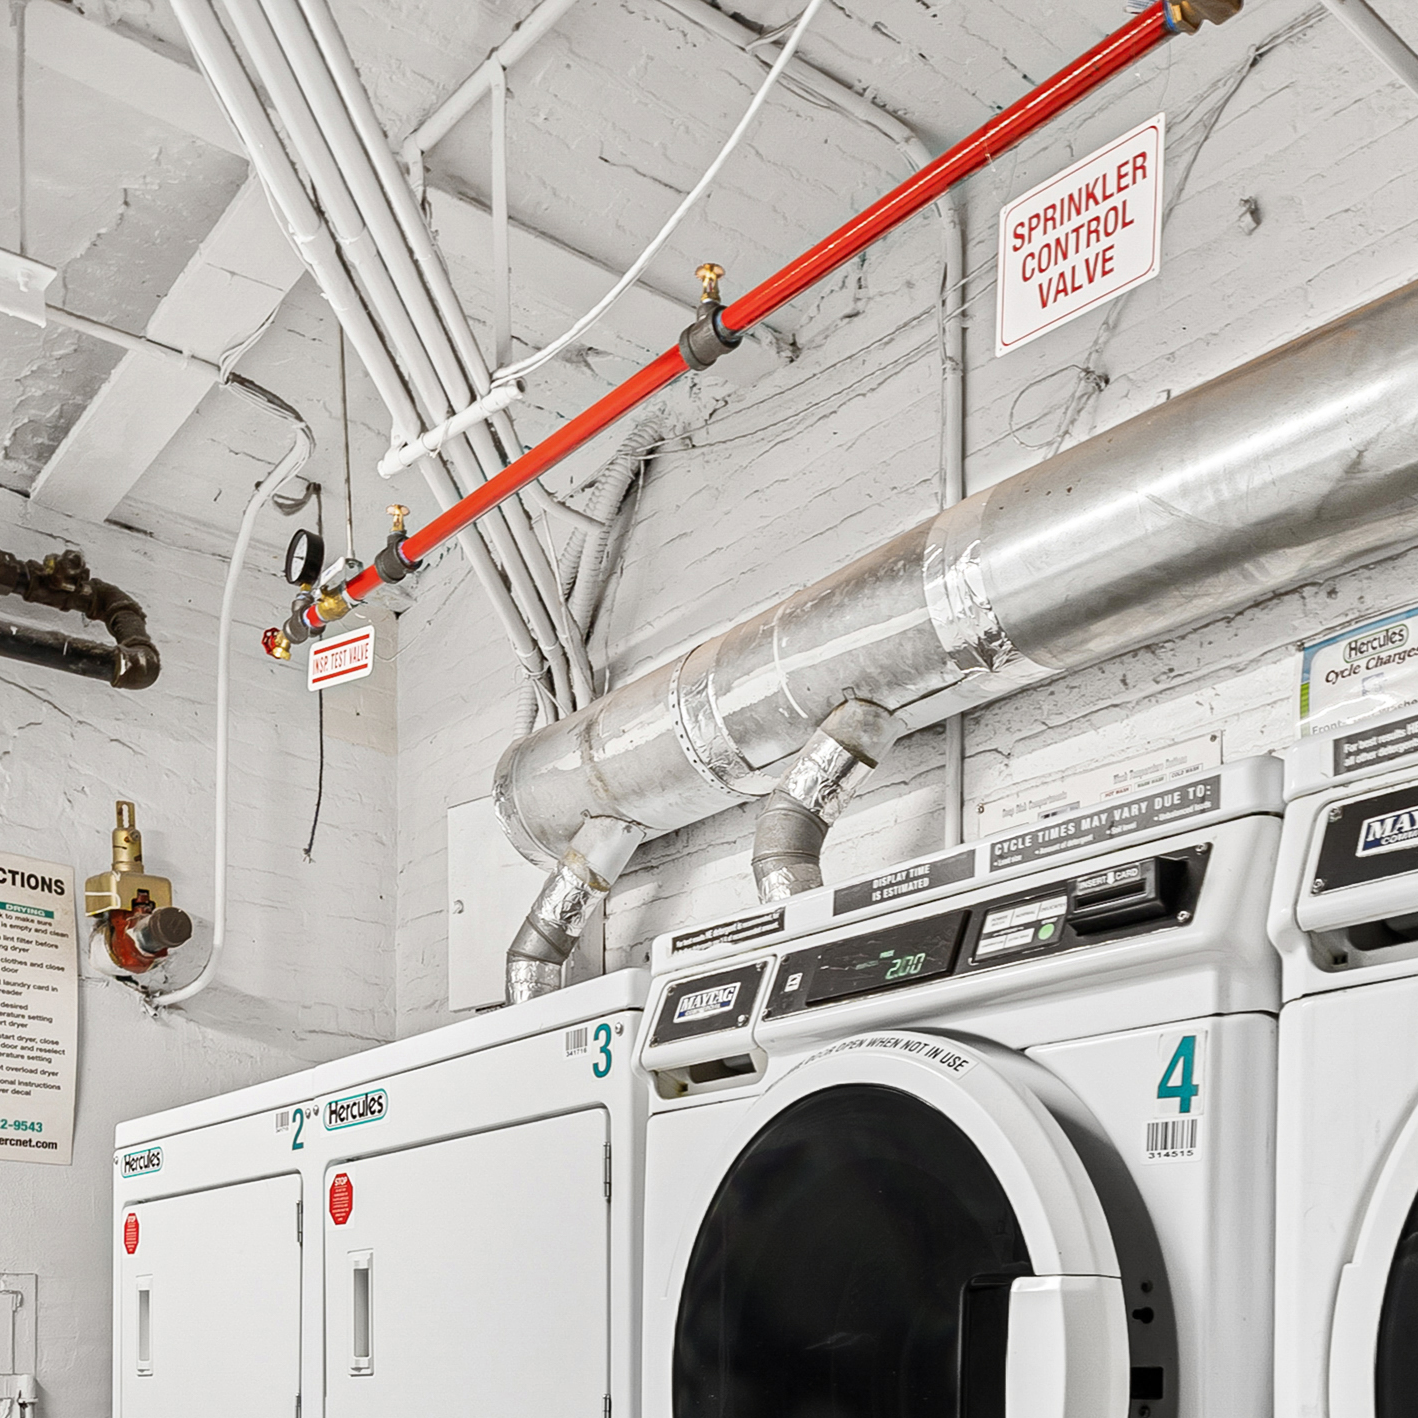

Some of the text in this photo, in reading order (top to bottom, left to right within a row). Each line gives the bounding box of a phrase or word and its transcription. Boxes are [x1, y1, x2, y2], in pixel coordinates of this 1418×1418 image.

[1013, 152, 1148, 252] SPRINKLER
[1022, 199, 1134, 282] CONTROL
[1038, 244, 1115, 309] VALVE
[1348, 628, 1405, 660] Hercules
[313, 643, 369, 675] INSP. TEST VALVE
[1325, 664, 1361, 684] Cycle
[1171, 770, 1185, 779] COLD
[995, 784, 1211, 856] CYCLE TIMES MAY VARY DUE TO:
[872, 864, 931, 888] DISPLAY TIME
[872, 878, 929, 901] IS ESTIMATED
[1079, 868, 1138, 890] INSERT CARD
[5, 904, 45, 917] DRYING
[885, 953, 925, 980] 2.00
[681, 988, 735, 1012] MAYTAG
[593, 1023, 612, 1078] 3
[836, 1037, 969, 1072] OPEN WHEN NOT IN USE
[1157, 1035, 1199, 1114] 4
[328, 1093, 384, 1125] Hercules
[291, 1108, 304, 1150] 2
[124, 1150, 161, 1174] Hercules
[1148, 1150, 1194, 1159] 314515
[334, 1176, 347, 1186] STOP
